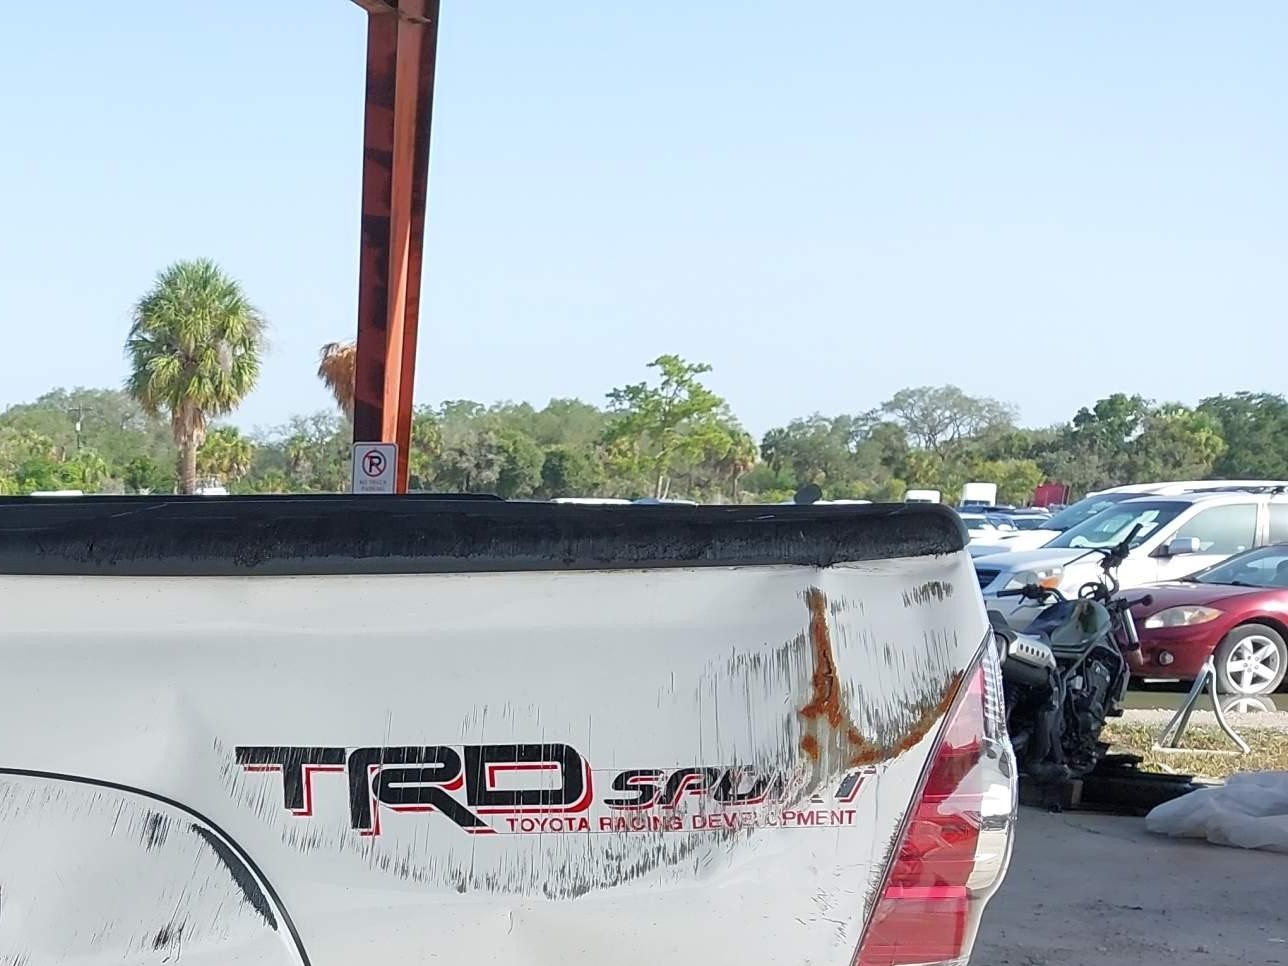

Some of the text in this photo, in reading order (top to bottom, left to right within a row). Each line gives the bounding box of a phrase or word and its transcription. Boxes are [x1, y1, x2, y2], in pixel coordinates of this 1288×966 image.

[235, 743, 593, 836] TRD
[506, 817, 590, 832] TOYOTA
[599, 815, 683, 831] RACING
